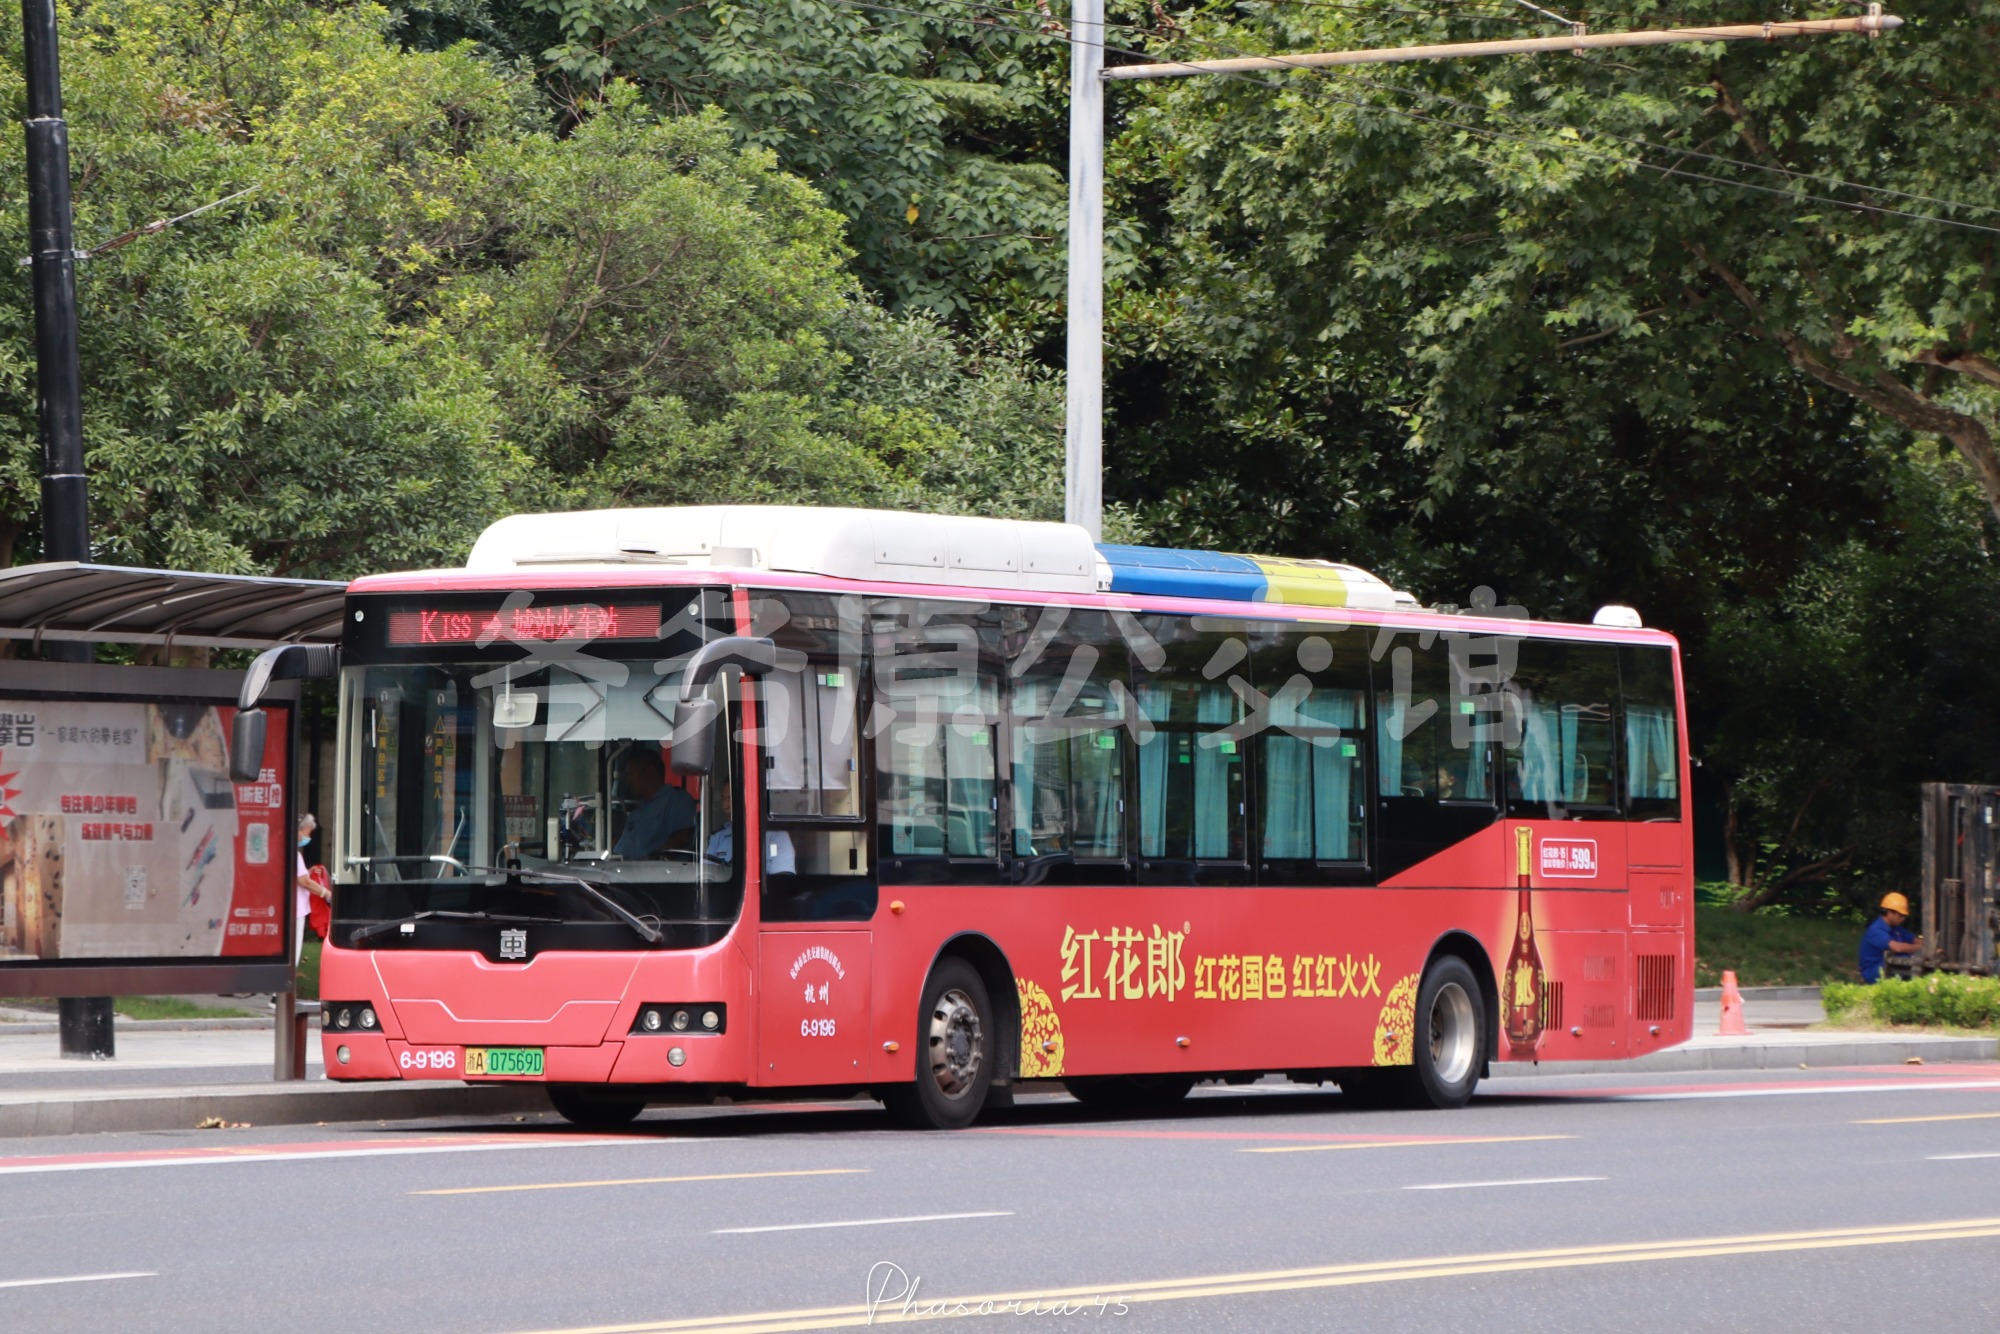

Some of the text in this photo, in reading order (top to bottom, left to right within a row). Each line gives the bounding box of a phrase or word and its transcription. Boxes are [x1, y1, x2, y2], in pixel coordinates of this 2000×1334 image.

[513, 606, 618, 639] 城站火车站
[1060, 923, 1186, 1003] 红花郎
[1194, 954, 1382, 1001] 红花国色 红红火火
[804, 981, 829, 1006] 杭州
[801, 1019, 836, 1037] 6-9196
[400, 1051, 456, 1069] 6-9196
